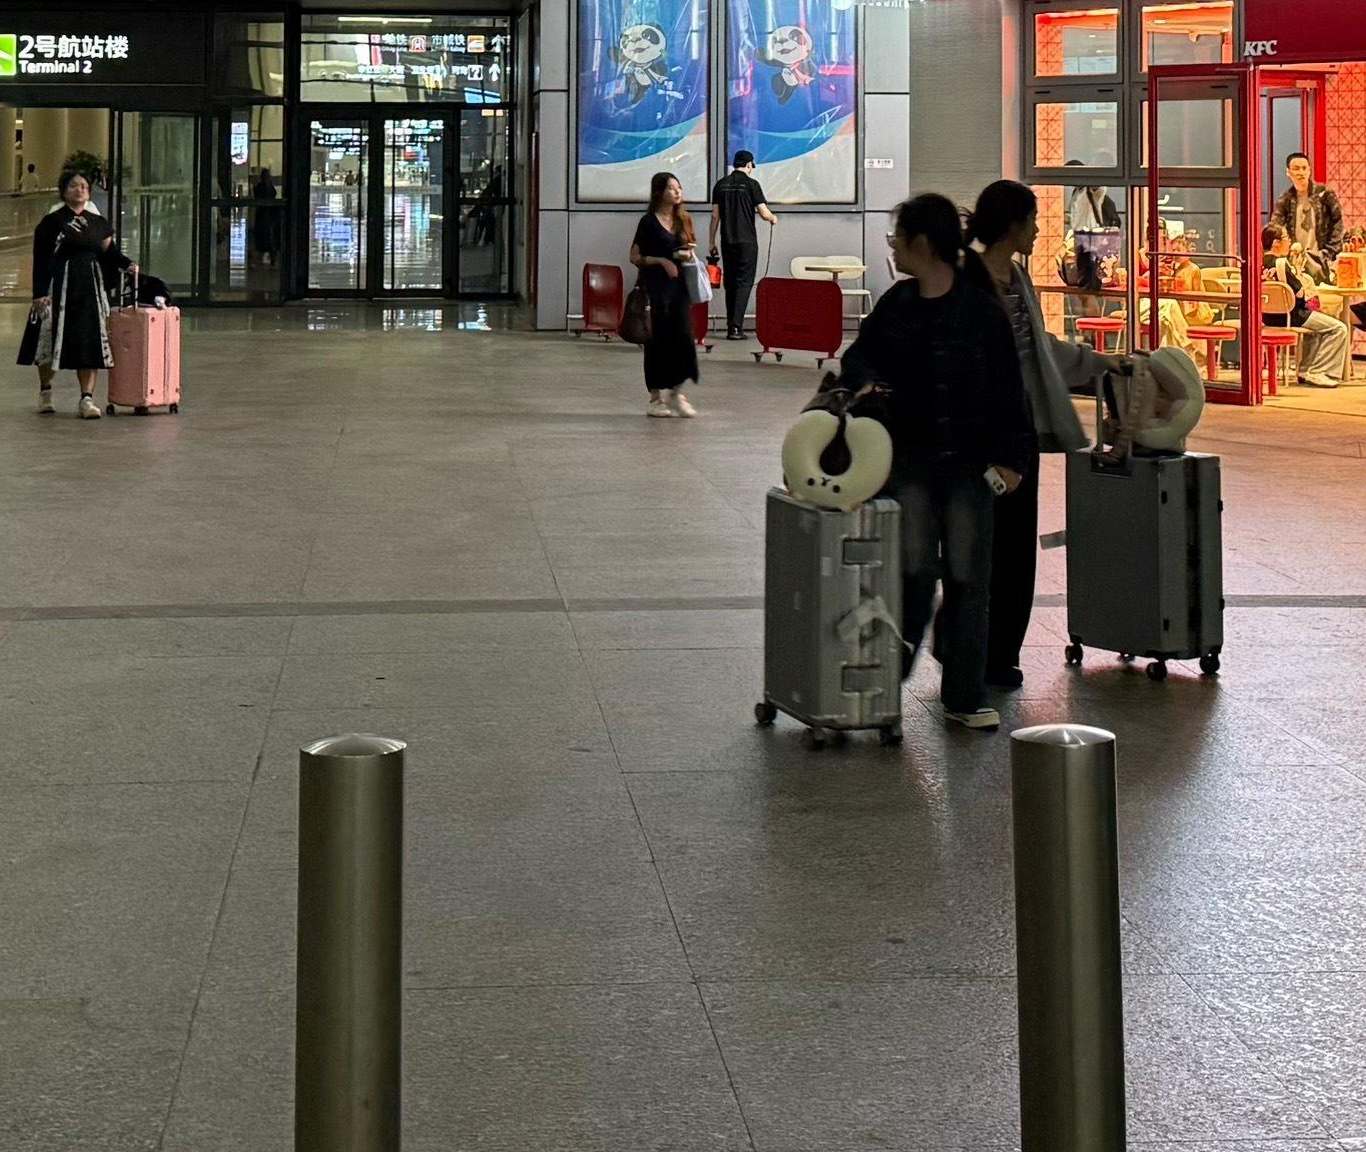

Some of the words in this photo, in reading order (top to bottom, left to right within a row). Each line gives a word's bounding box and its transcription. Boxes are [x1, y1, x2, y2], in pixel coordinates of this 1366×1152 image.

[18, 34, 129, 59] 2号航站楼
[1243, 39, 1278, 56] KFC
[19, 59, 80, 74] Terminal
[82, 60, 93, 74] 2
